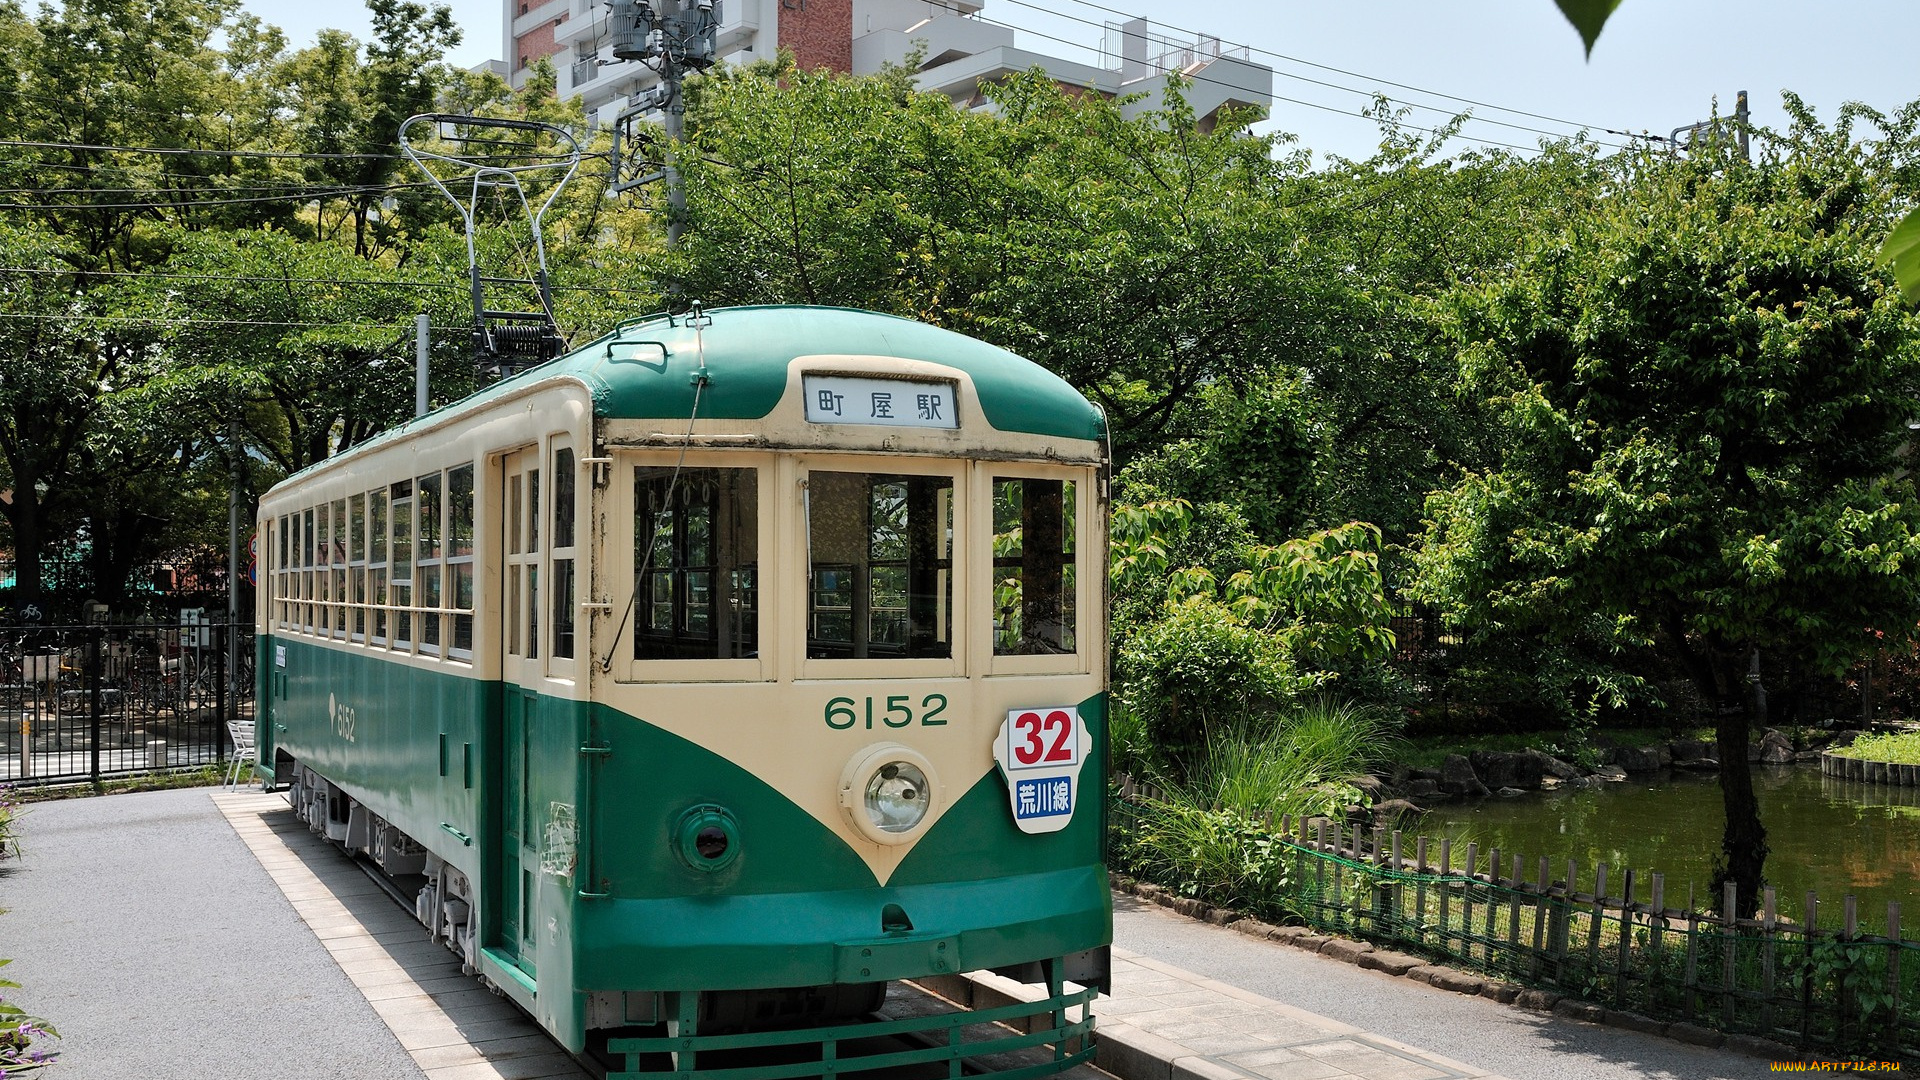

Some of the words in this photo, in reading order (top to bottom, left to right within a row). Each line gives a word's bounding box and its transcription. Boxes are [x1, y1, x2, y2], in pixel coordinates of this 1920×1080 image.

[818, 390, 942, 420] 町屋駅
[337, 703, 355, 743] 6152
[824, 693, 948, 730] 6152
[1014, 710, 1072, 765] 32
[1019, 780, 1069, 815] 荒川線
